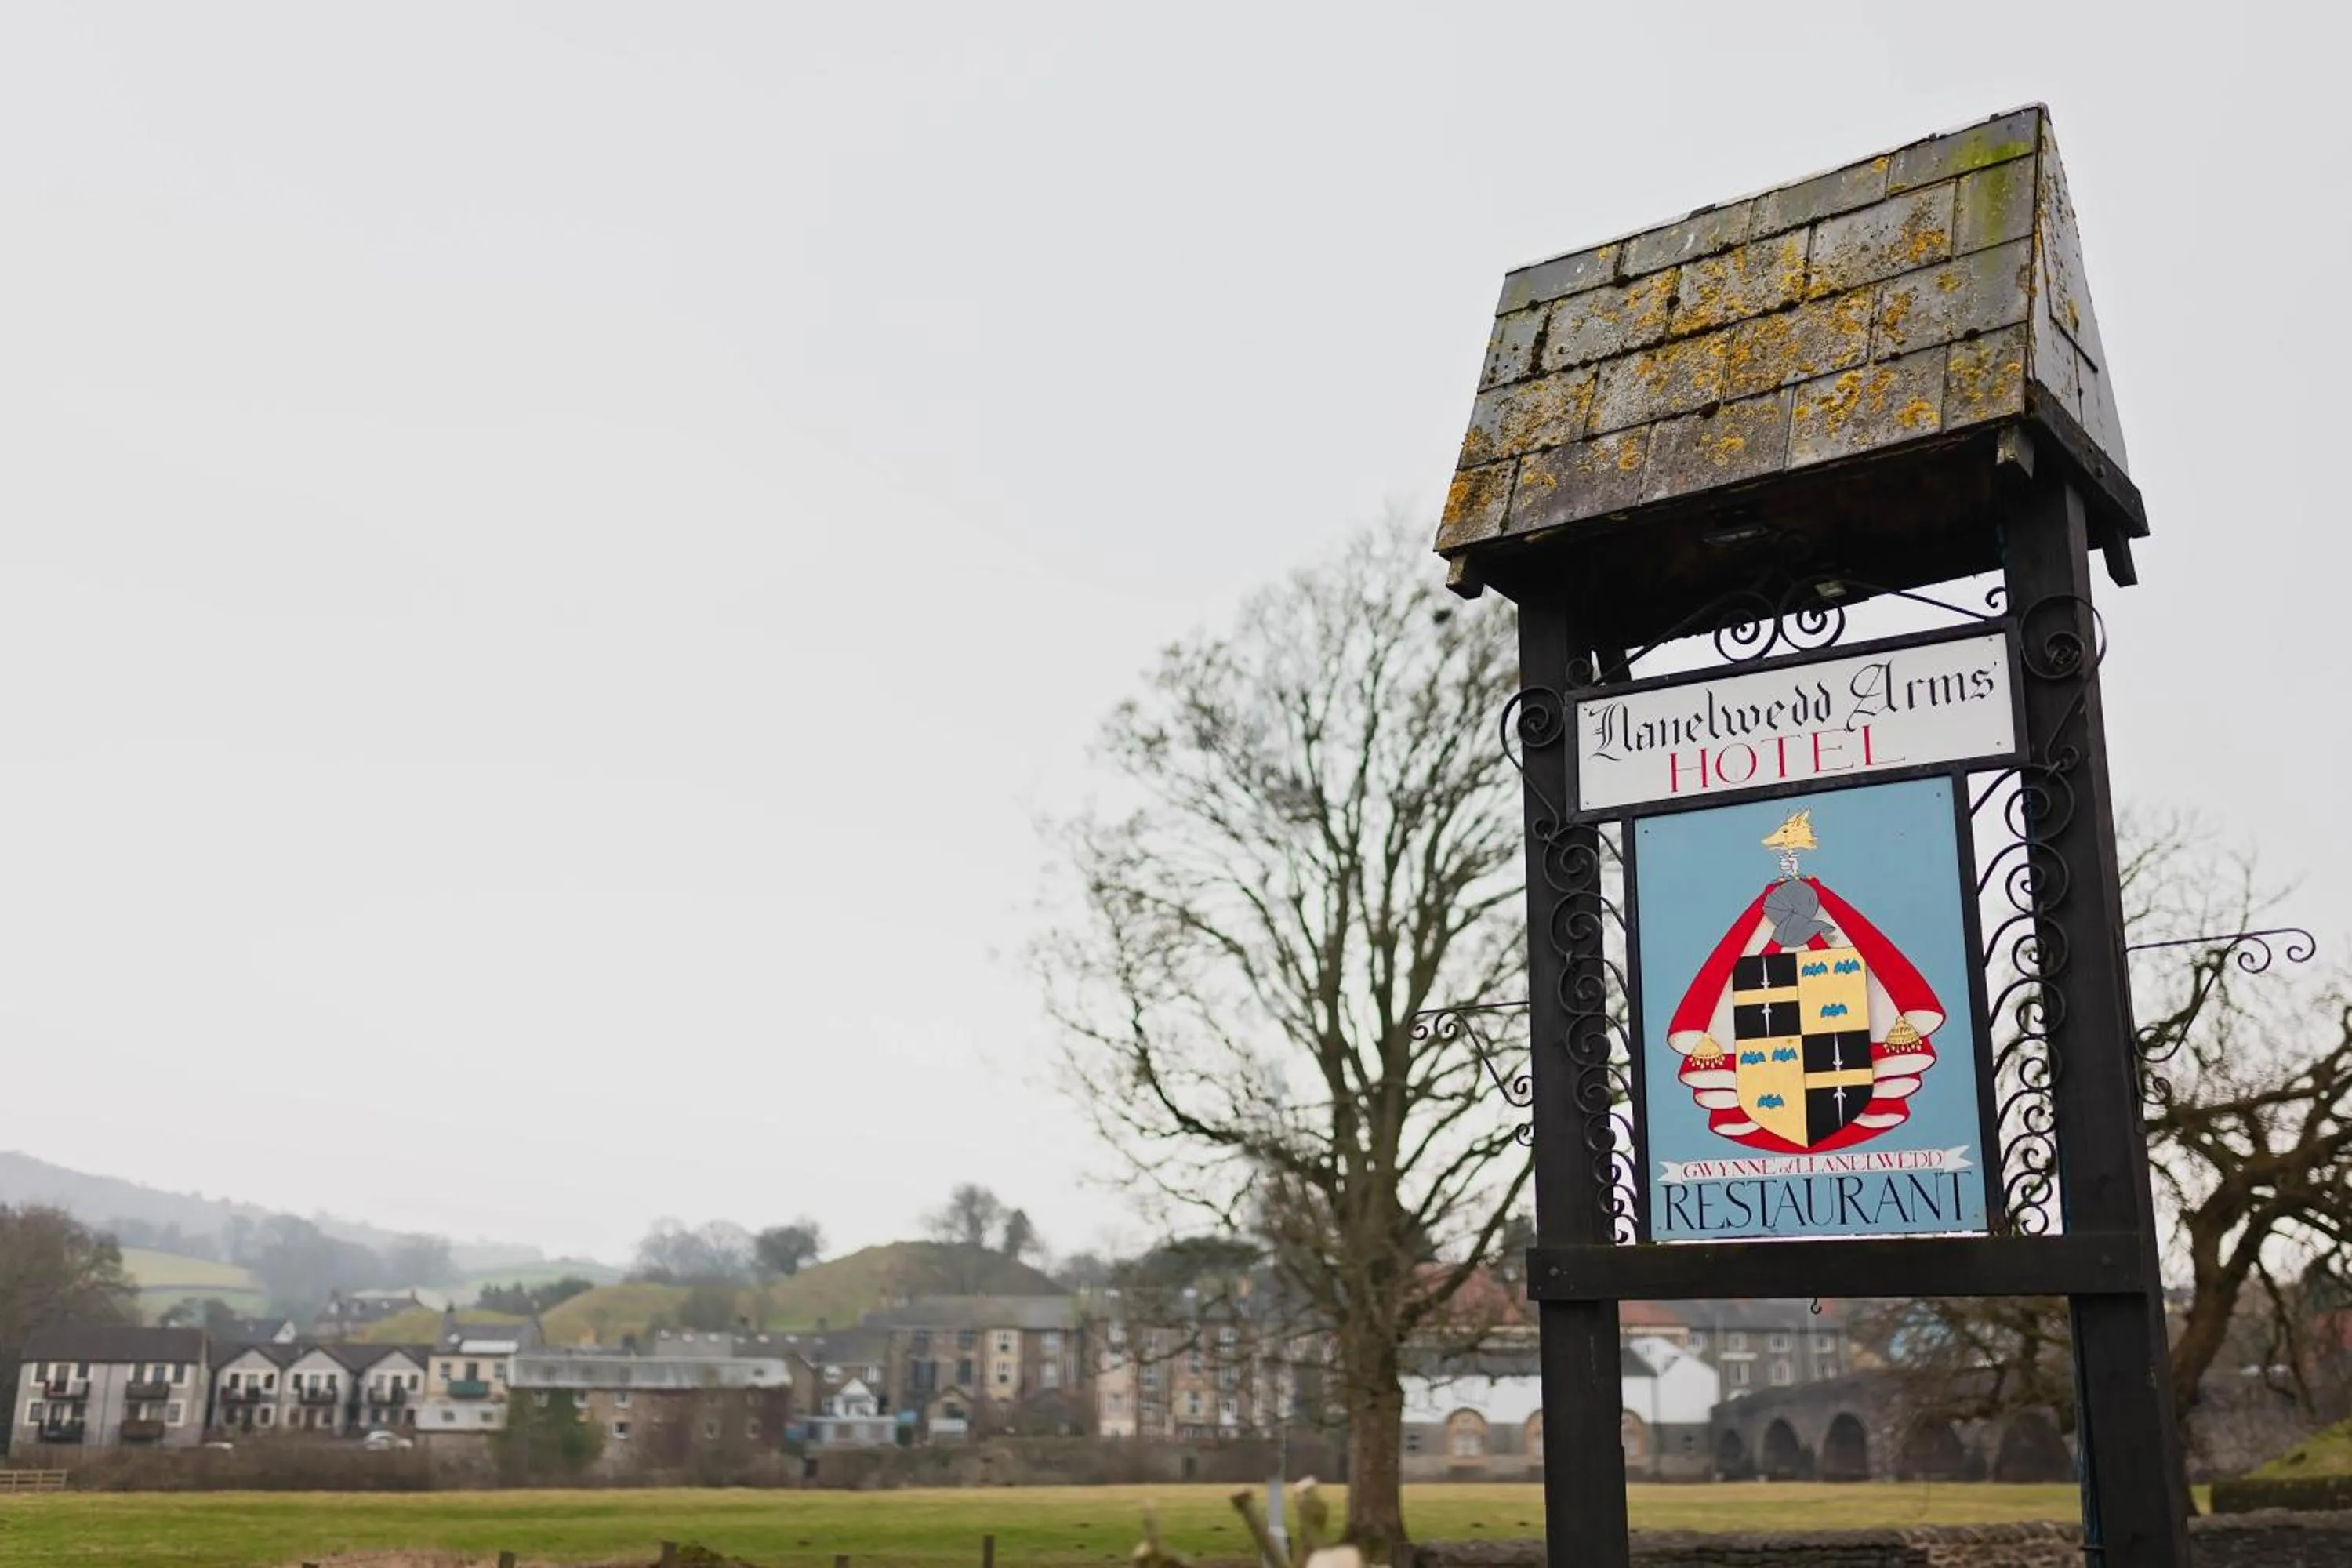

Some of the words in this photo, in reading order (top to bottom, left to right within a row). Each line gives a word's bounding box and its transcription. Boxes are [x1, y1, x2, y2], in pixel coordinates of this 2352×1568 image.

[1847, 659, 1997, 732] Arms
[1669, 724, 1906, 793] HOTEL
[1683, 1159, 1776, 1178] GWYNNE
[1661, 1171, 1972, 1231] RESTAURANT
